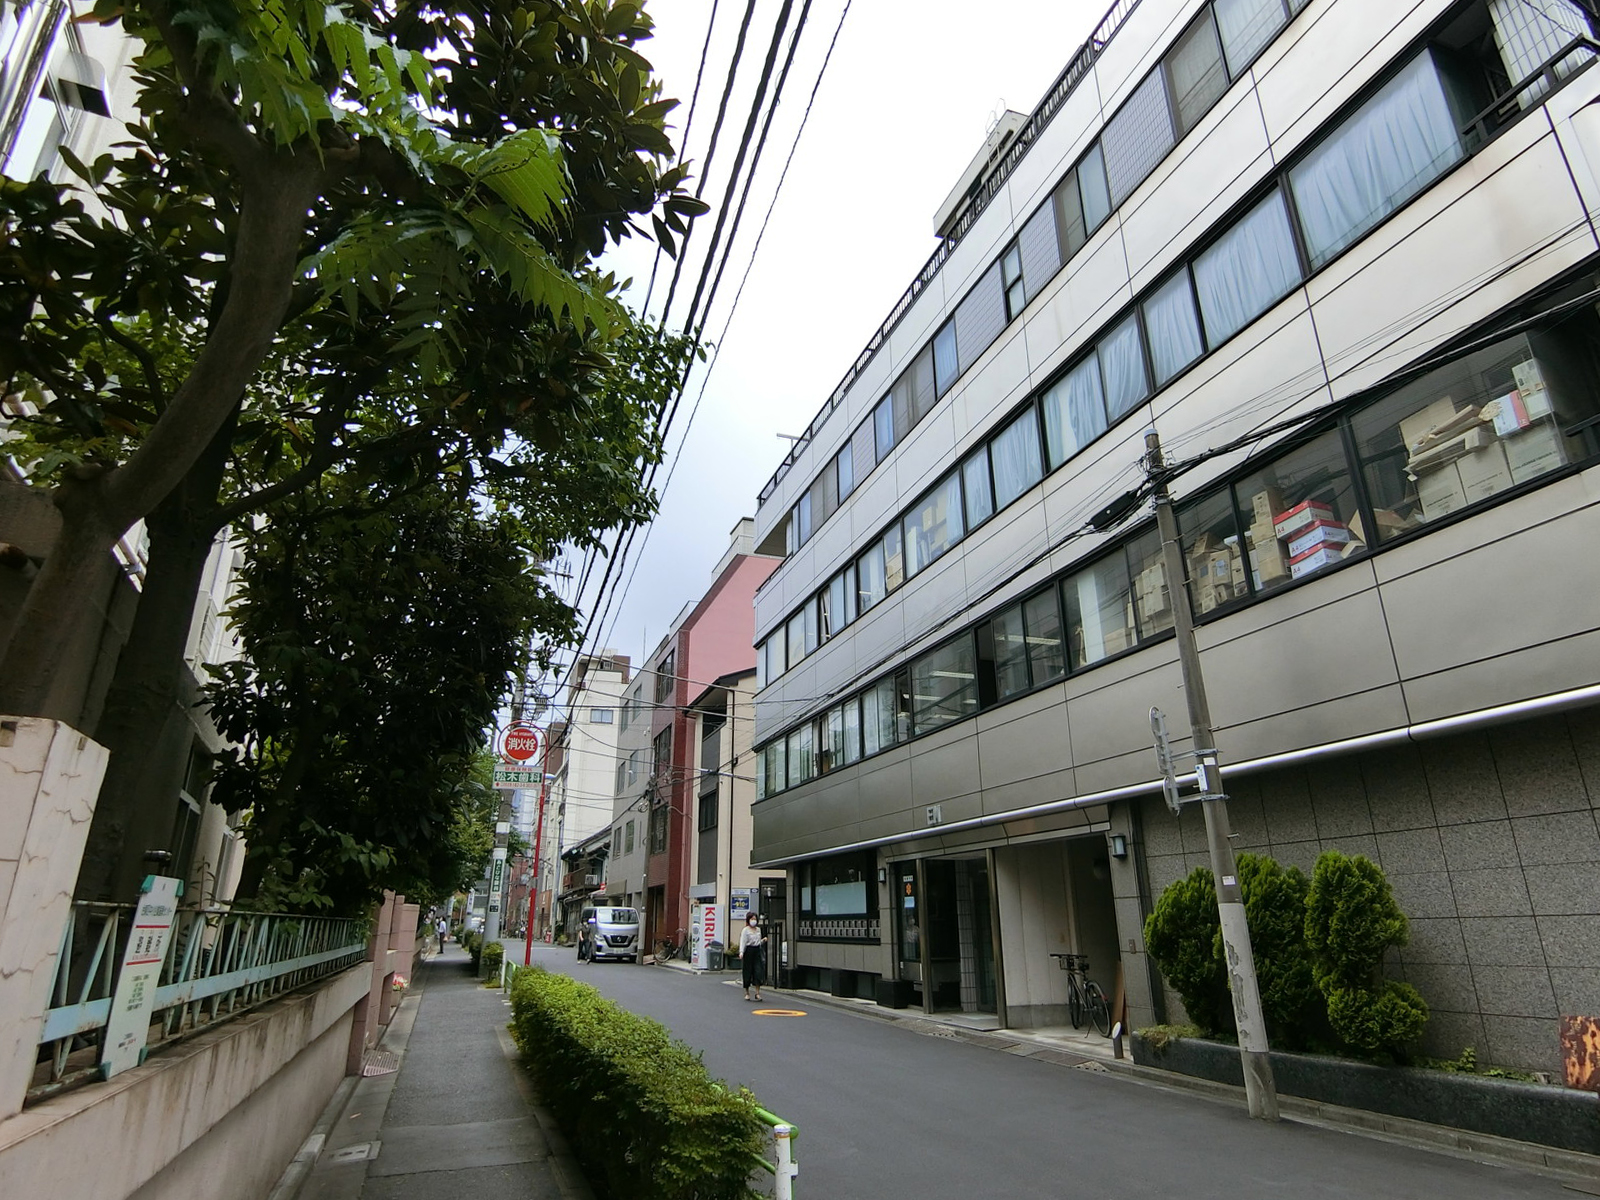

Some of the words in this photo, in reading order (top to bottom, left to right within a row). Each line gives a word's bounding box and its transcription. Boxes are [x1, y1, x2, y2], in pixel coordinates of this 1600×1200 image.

[1277, 526, 1285, 534] A4
[1291, 545, 1299, 553] A4
[1293, 566, 1301, 574] A4
[507, 737, 536, 751] 消火栓
[495, 771, 540, 783] 松木歯科
